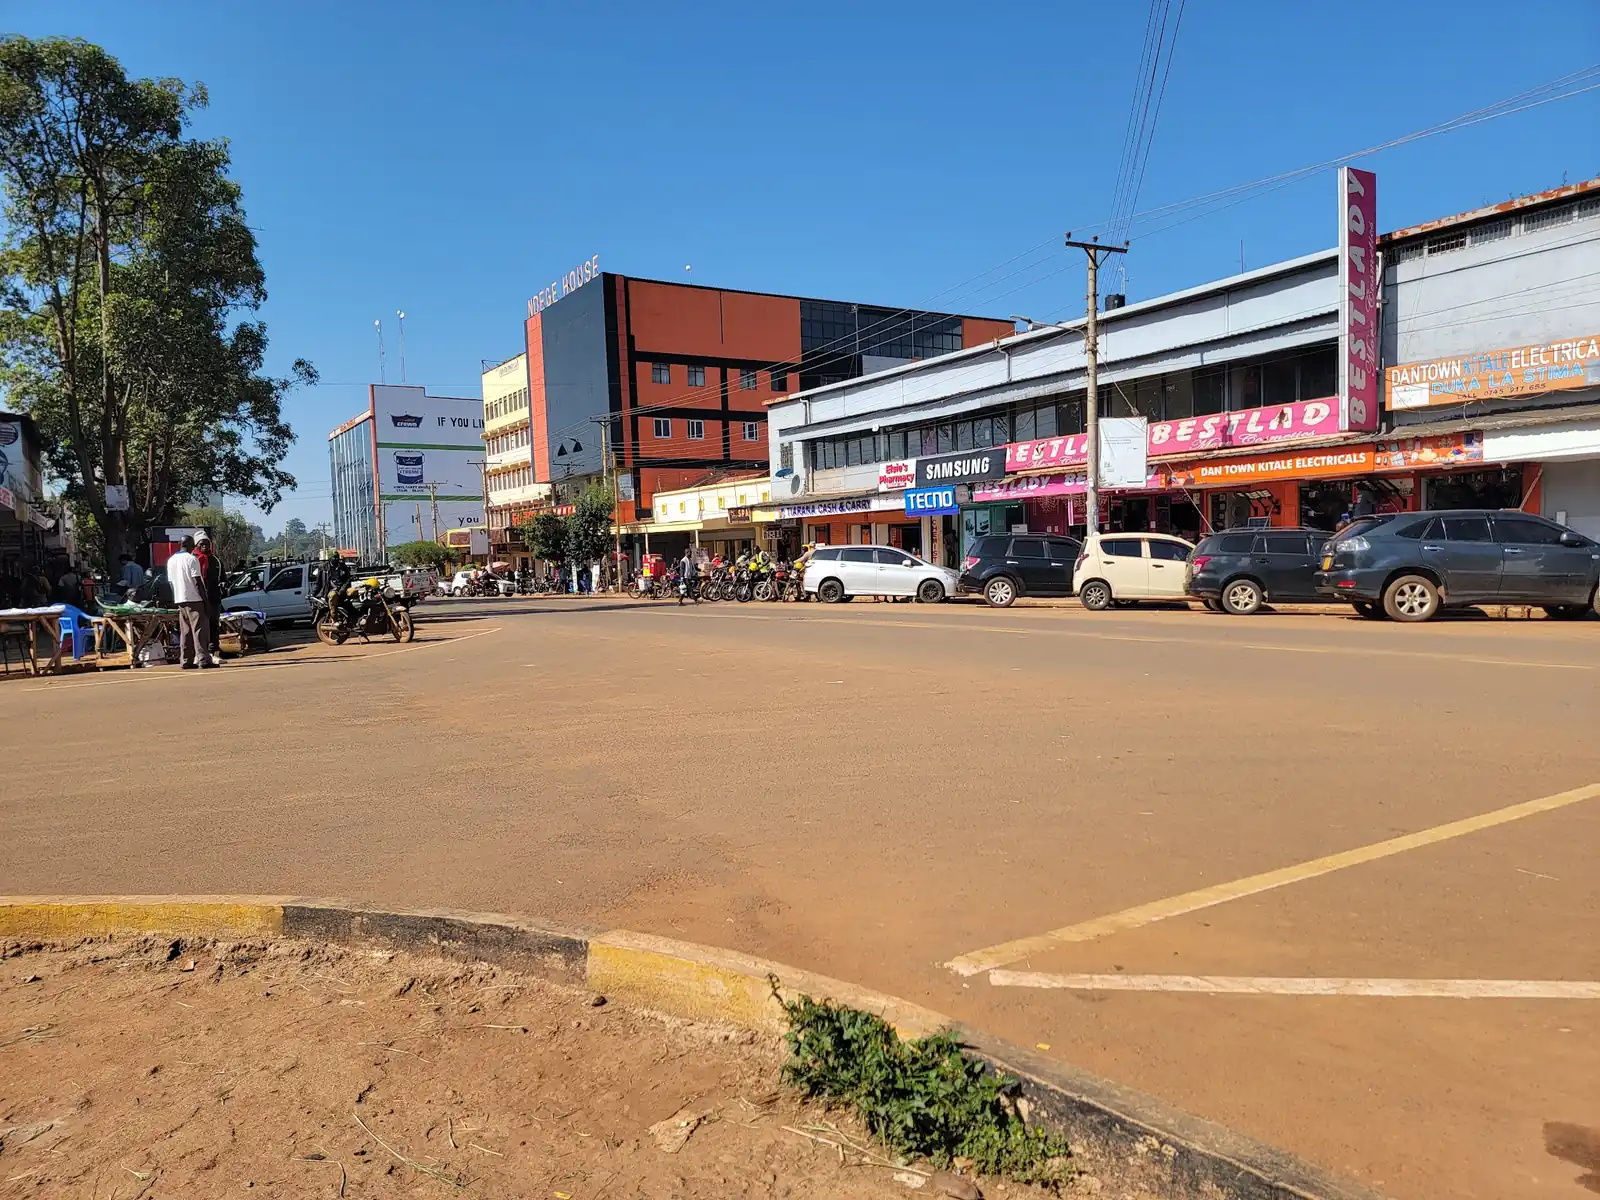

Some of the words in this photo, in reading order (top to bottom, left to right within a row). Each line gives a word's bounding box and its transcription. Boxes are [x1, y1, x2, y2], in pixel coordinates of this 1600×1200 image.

[1366, 221, 1376, 313] Cosmetics
[527, 281, 558, 318] NDEGE
[562, 254, 599, 297] HOUSE
[1349, 169, 1367, 425] BESTLADY
[1391, 360, 1461, 386] DANTOWN
[1511, 339, 1600, 369] ELECTRICA
[1431, 377, 1480, 396] DUKA
[1488, 372, 1515, 388] LA
[1523, 362, 1584, 384] STIMA
[437, 416, 446, 427] IF
[450, 417, 469, 428] YOU
[926, 457, 990, 480] SAMSUNG
[1201, 466, 1222, 477] DAN
[1224, 462, 1255, 474] TOWN
[1258, 459, 1293, 472] KITALE
[1295, 452, 1366, 469] ELECTRICALS
[879, 473, 915, 485] Pharmacy
[817, 502, 837, 514] CASH
[845, 499, 871, 511] CARRY
[907, 490, 953, 510] TECNO
[457, 516, 479, 527] you
